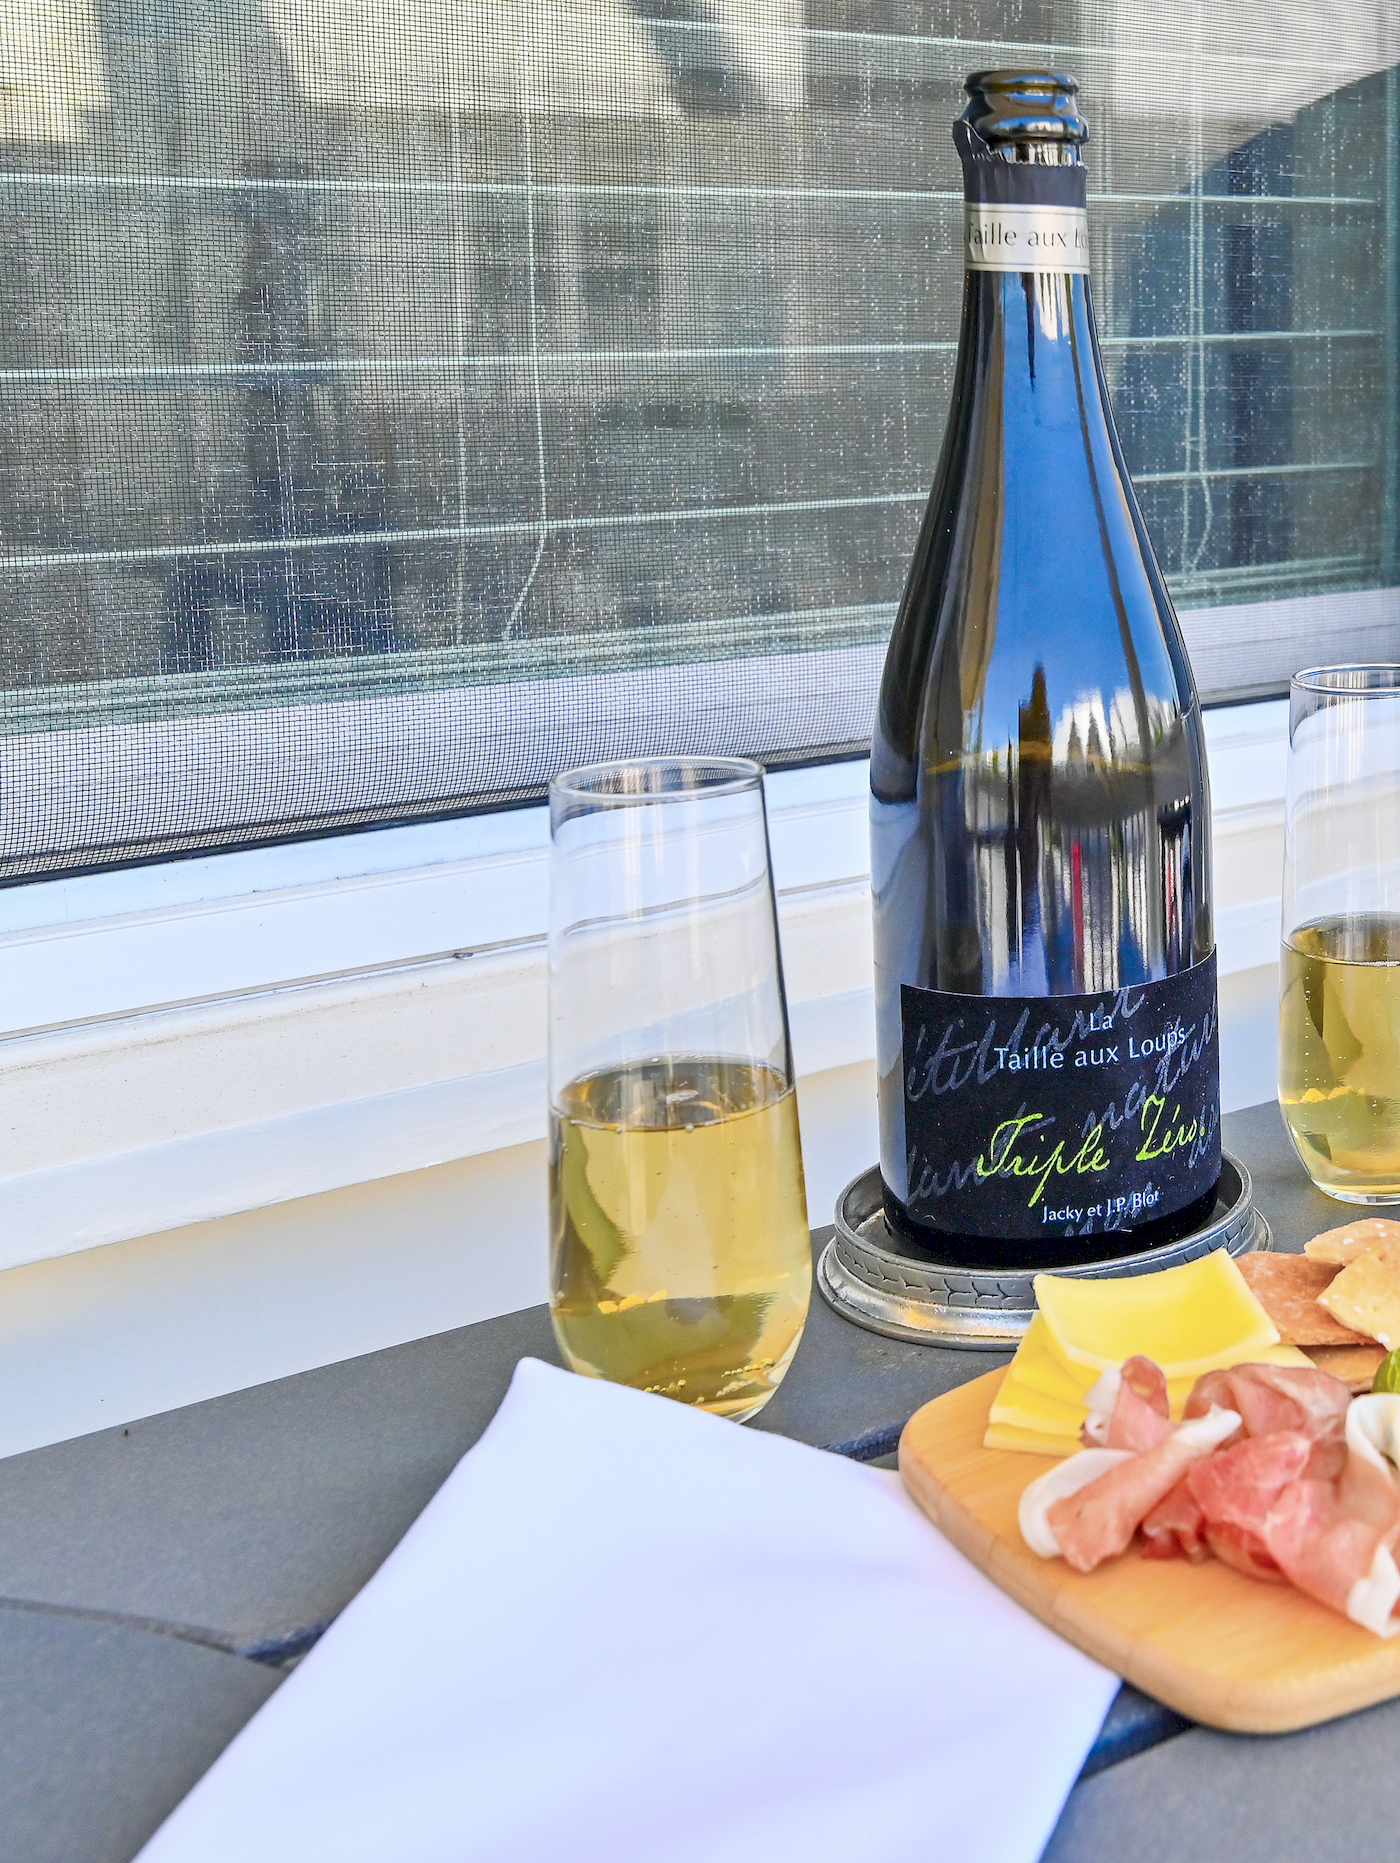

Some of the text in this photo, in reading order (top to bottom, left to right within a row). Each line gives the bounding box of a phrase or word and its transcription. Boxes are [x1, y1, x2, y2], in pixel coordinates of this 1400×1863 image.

[966, 222, 1089, 249] Taille aux Lo
[1089, 1012, 1114, 1032] La
[994, 1027, 1186, 1070] Taille aux Loups
[976, 1113, 1111, 1208] Triple
[1042, 1190, 1160, 1224] Jacky et J.P. Blot
